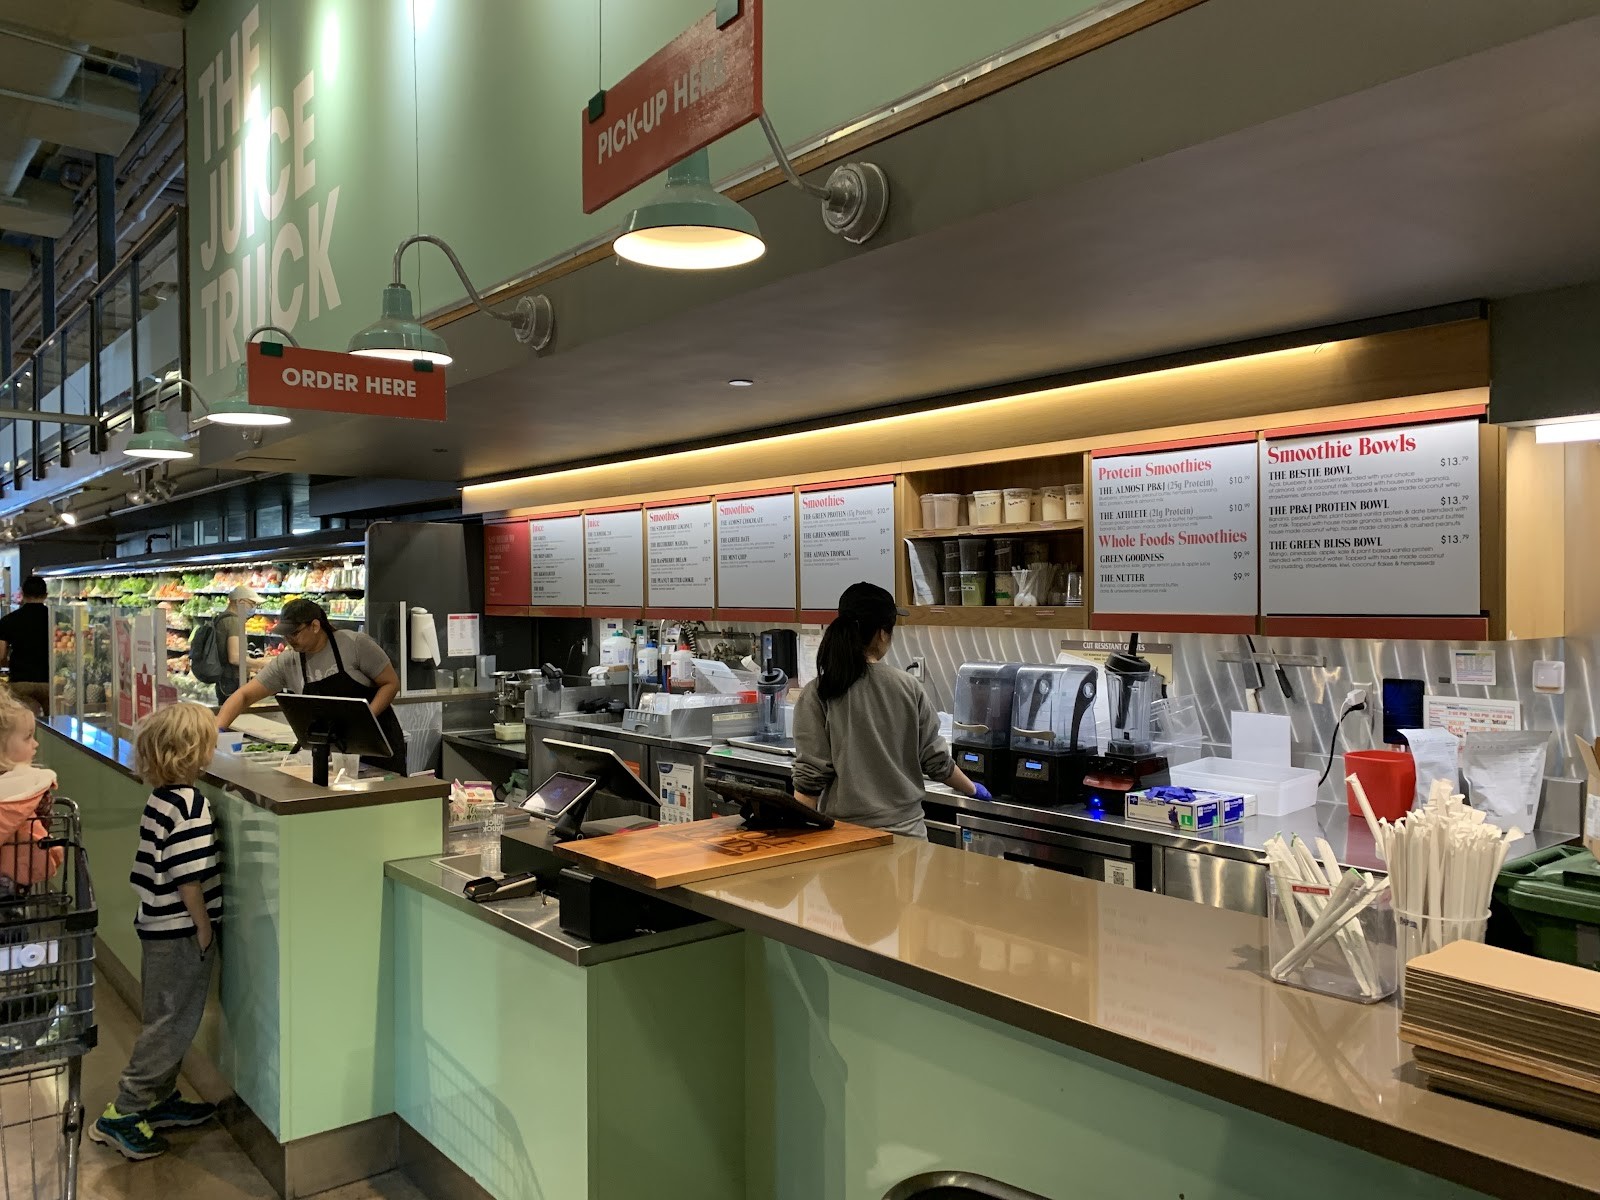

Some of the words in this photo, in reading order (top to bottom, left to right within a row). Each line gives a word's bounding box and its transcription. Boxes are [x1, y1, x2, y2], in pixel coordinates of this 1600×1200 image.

[198, 3, 261, 165] THE
[598, 89, 668, 164] PICK-UP
[201, 69, 316, 272] JUICE
[201, 186, 342, 376] TRUCK
[281, 367, 359, 393] ORDER
[366, 376, 417, 398] HERE
[1268, 440, 1352, 464] Smoothie
[1359, 434, 1416, 456] Bowls
[1098, 464, 1142, 481] Protein
[1145, 458, 1212, 477] Smoothies
[1269, 471, 1286, 480] THE
[1289, 468, 1321, 479] BESTIE
[1324, 465, 1352, 476] BOWL
[1099, 487, 1113, 496] THE
[1115, 483, 1145, 494] ALMOST
[1147, 481, 1166, 491] PB&J
[1184, 478, 1214, 488] Protein)
[803, 495, 845, 509] Smoothies
[1269, 506, 1287, 515] THE
[1290, 504, 1312, 514] PB&J
[1315, 501, 1357, 513] PROTEIN
[1360, 499, 1389, 510] BOWL
[649, 511, 680, 522] Smoothies
[719, 503, 755, 516] Smoothies
[812, 512, 826, 520] GREEN
[827, 510, 846, 519] PROTEIN
[1100, 511, 1114, 520] THE
[1115, 509, 1148, 519] ATHLETE
[1165, 506, 1194, 516] Protein)
[532, 524, 544, 533] Juice
[587, 518, 600, 528] Juice
[1098, 533, 1136, 548] Whole
[1139, 532, 1175, 546] Foods
[1178, 529, 1248, 545] Smoothies
[1269, 541, 1287, 550] THE
[1290, 539, 1321, 549] GREEN
[1324, 538, 1351, 548] BLISS
[1354, 537, 1383, 547] BOWL
[1100, 554, 1123, 563] GREEN
[1125, 552, 1164, 562] GOODNESS
[1100, 574, 1115, 583] THE
[1116, 573, 1145, 582] NUTTER
[1082, 641, 1093, 649] CUT
[1184, 817, 1191, 825] L
